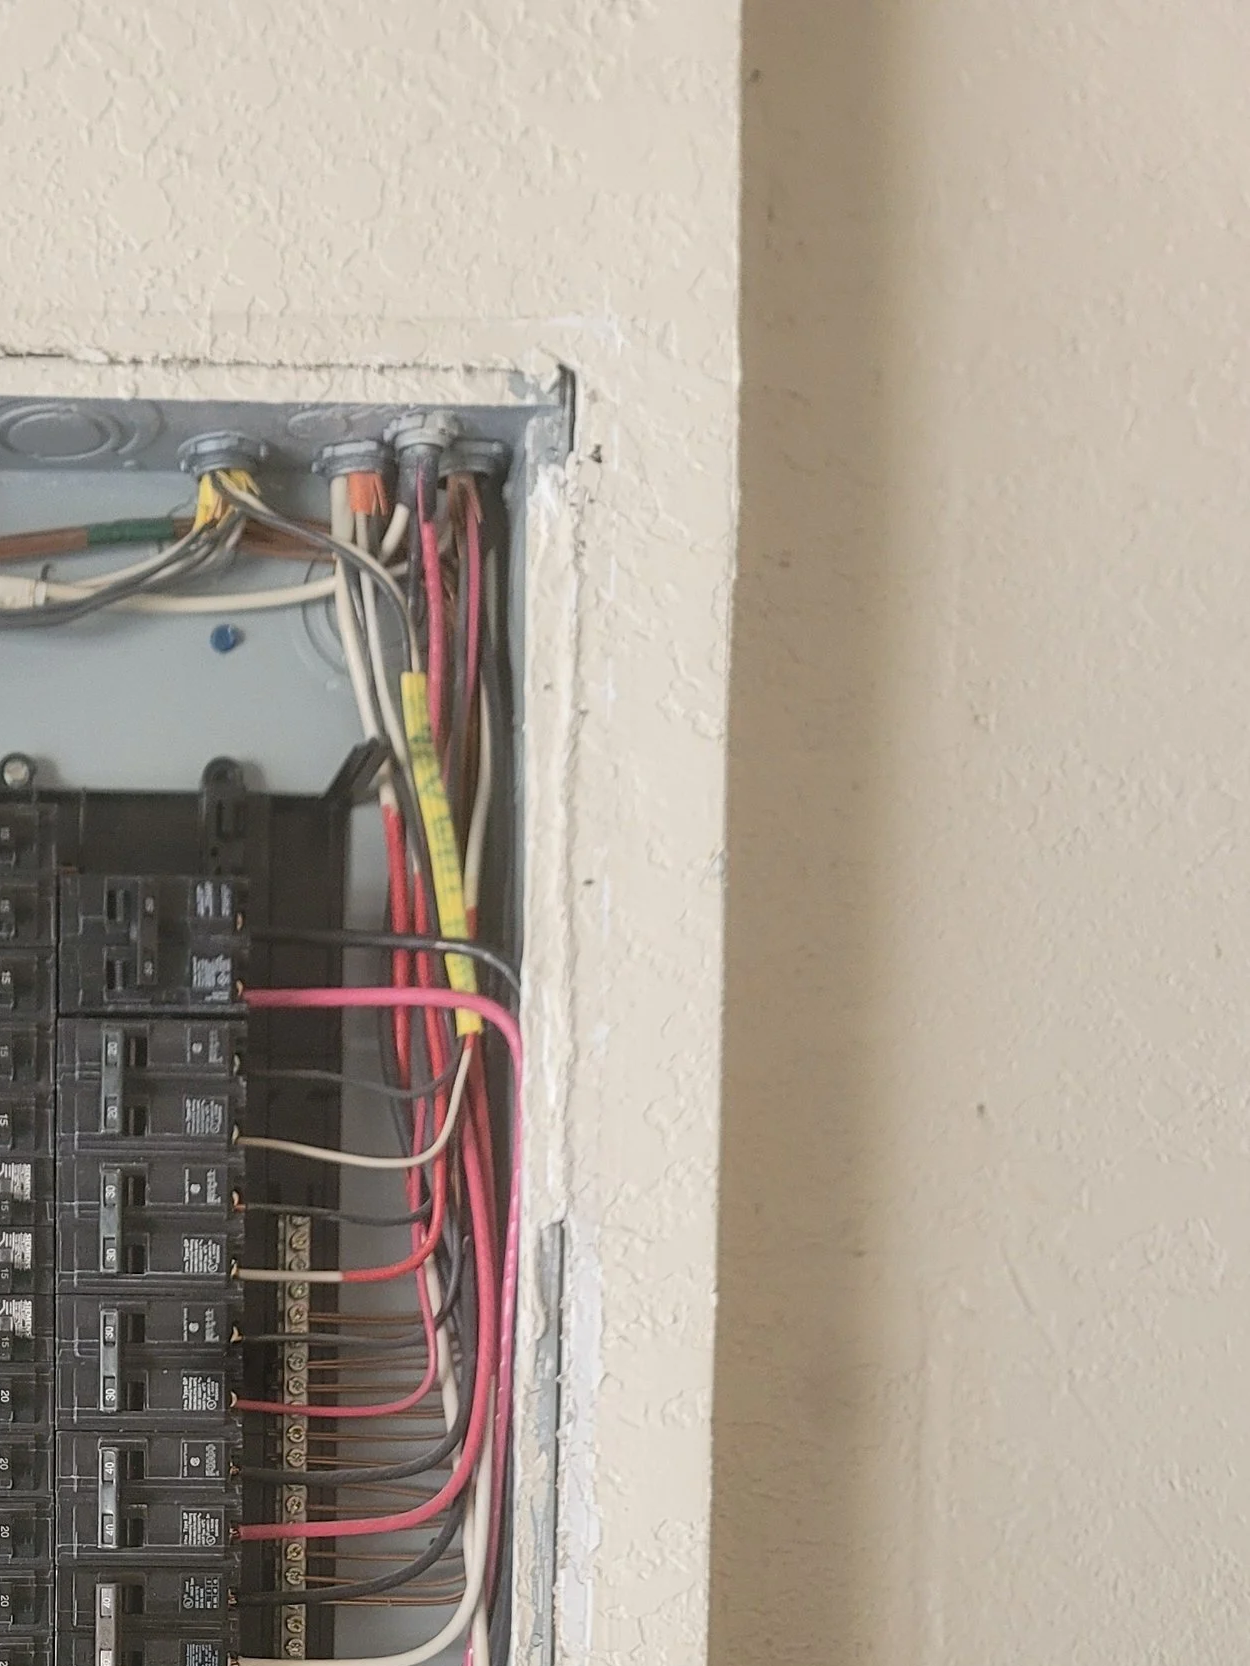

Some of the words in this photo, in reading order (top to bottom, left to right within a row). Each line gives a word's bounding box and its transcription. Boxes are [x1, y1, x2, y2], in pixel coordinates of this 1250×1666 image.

[1, 970, 10, 985] 15
[0, 1046, 8, 1057] 15
[107, 1041, 117, 1055] 20
[107, 1106, 117, 1119] 20
[0, 1113, 8, 1127] 15
[105, 1185, 115, 1198] 30
[1, 1200, 8, 1211] 15
[106, 1248, 116, 1261] 30
[1, 1268, 8, 1279] 15
[104, 1326, 114, 1339] 30
[2, 1336, 8, 1348] 15
[0, 1390, 9, 1402] 20
[105, 1388, 115, 1401] 30
[0, 1457, 8, 1470] 20
[104, 1461, 114, 1474] 40
[1, 1525, 9, 1538] 20
[106, 1524, 114, 1536] 40
[0, 1595, 9, 1607] 20
[103, 1598, 111, 1608] 40
